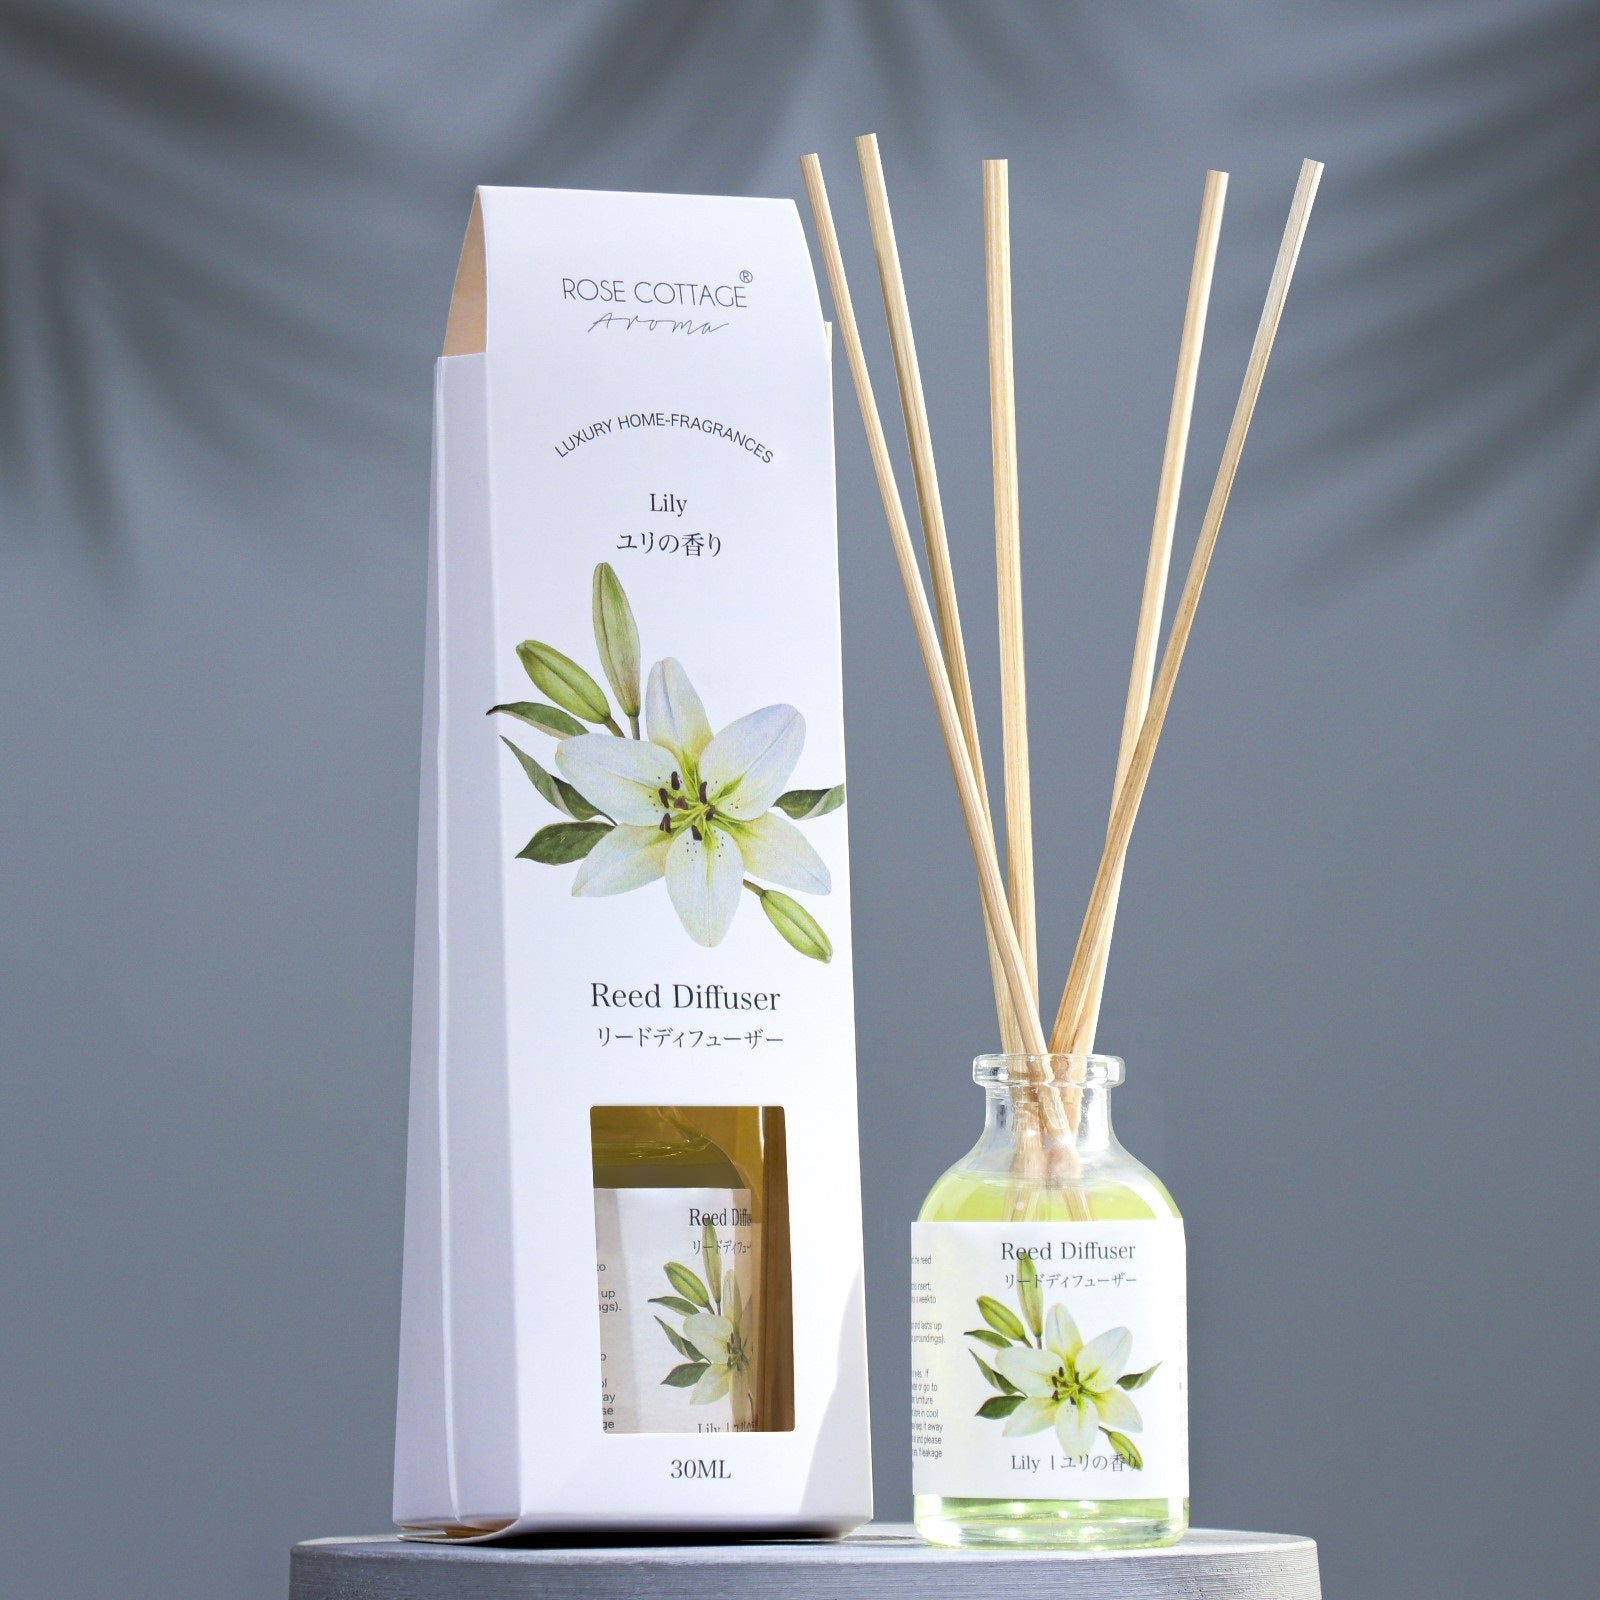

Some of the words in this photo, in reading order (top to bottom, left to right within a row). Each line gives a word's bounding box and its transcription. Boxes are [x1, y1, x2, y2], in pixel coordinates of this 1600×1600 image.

[562, 277, 627, 303] ROSE
[587, 312, 730, 335] Aroma
[554, 418, 613, 458] LUXURY
[617, 412, 774, 464] HOME-FRAGRANCES
[649, 493, 688, 518] Lily
[616, 531, 722, 558] ユリの香り
[590, 982, 662, 1009] Reed
[672, 983, 781, 1011] Diffuser
[598, 1026, 784, 1050] リードディフューザー
[688, 1208, 728, 1227] Reed
[1000, 1241, 1053, 1261] Reed
[1060, 1240, 1136, 1261] Diffuser
[1004, 1271, 1138, 1289] リードディフューザー
[601, 1290, 616, 1304] up
[931, 1382, 938, 1392] to
[670, 1459, 732, 1479] 30ML
[1011, 1454, 1041, 1474] Lily
